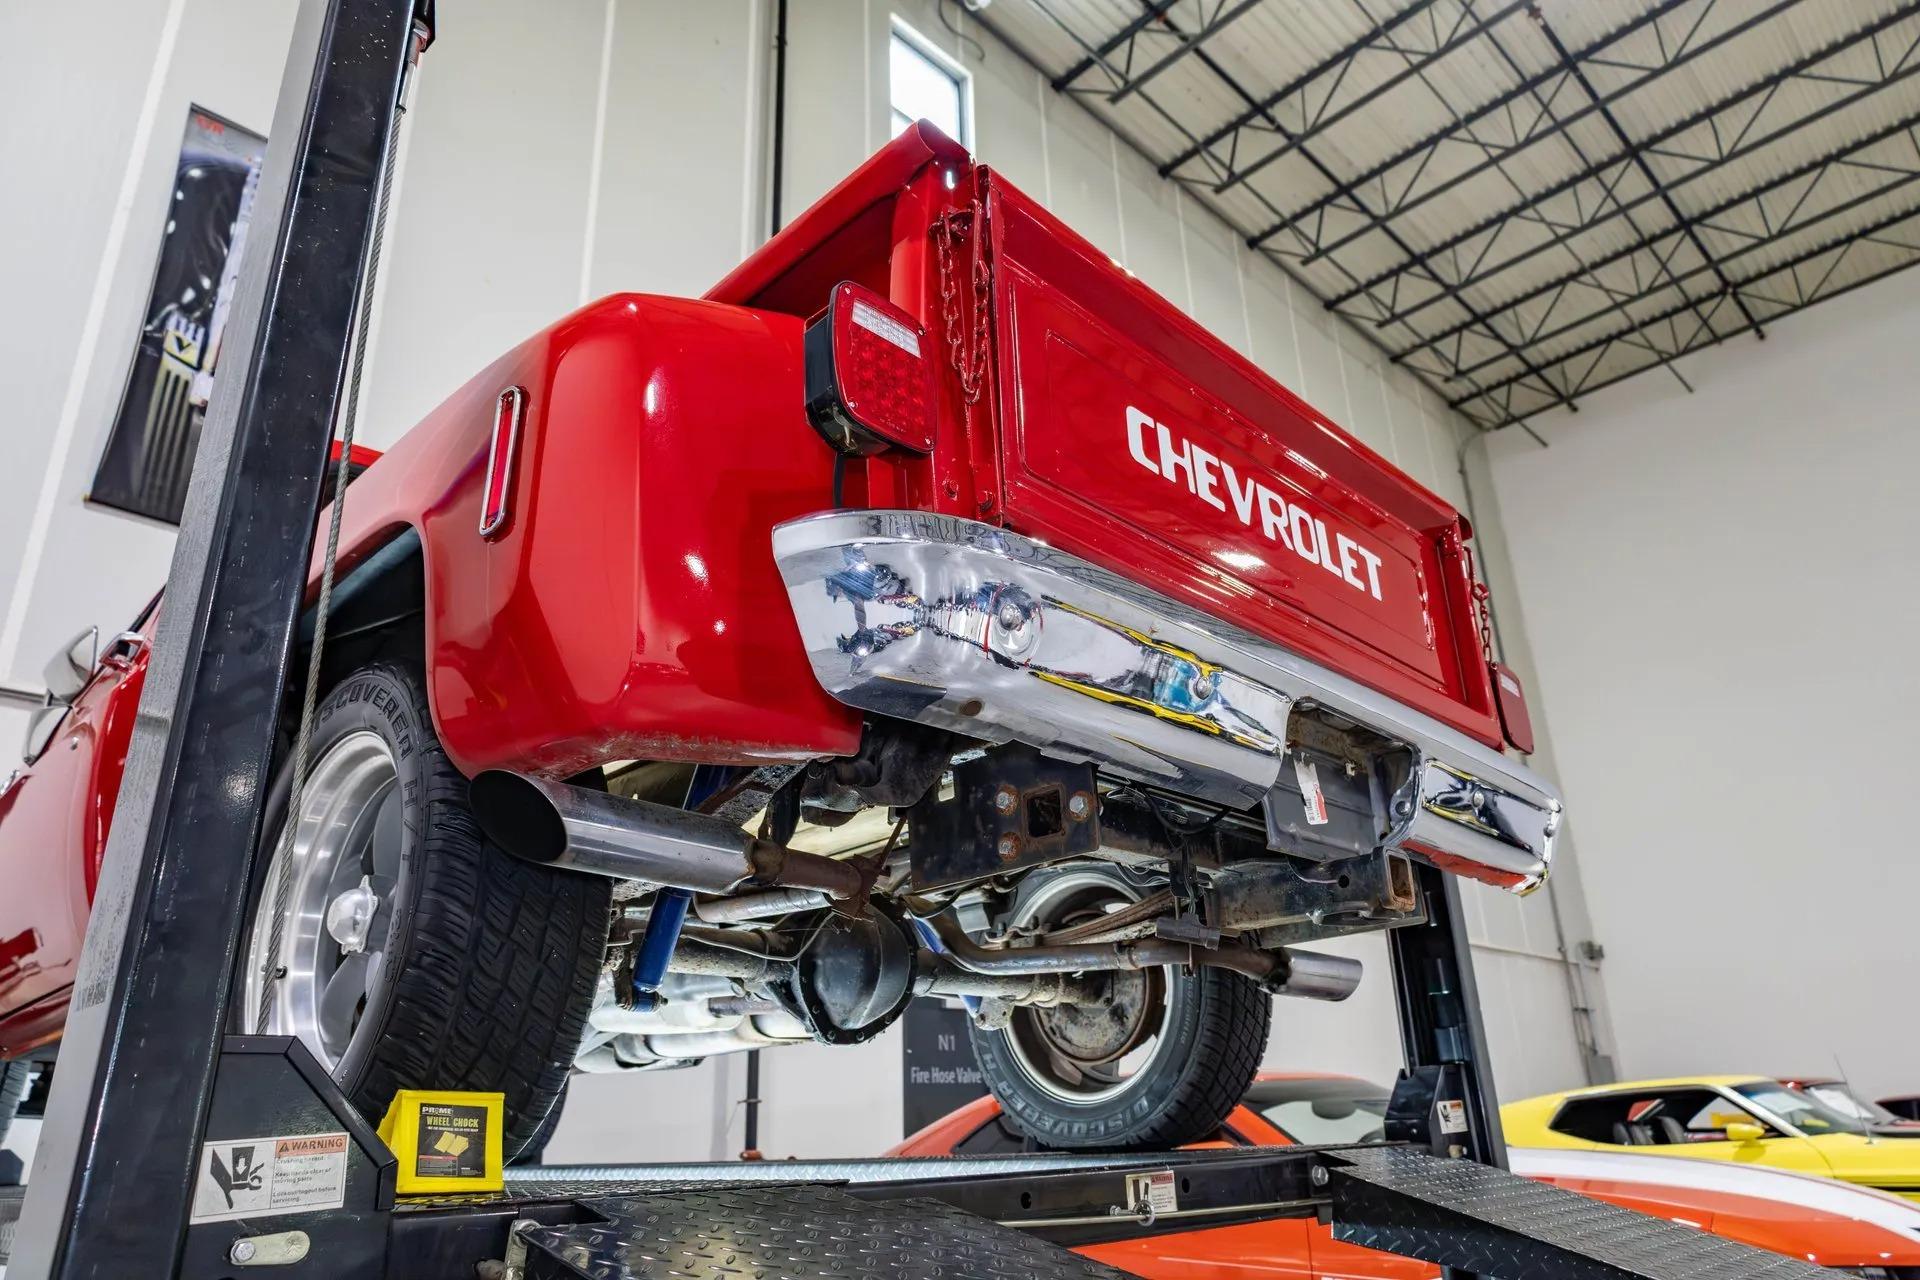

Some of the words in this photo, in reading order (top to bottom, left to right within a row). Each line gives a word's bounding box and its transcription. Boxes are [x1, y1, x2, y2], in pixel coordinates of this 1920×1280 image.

[1125, 405, 1382, 602] CHEVROLET
[313, 682, 414, 759] ISCOVERER
[938, 1034, 955, 1051] N1
[911, 1066, 930, 1084] Fire
[931, 1066, 955, 1084] Hose
[956, 1066, 983, 1084] Valve
[998, 1079, 1150, 1138] DISCOVERER
[426, 1115, 450, 1127] WHEEL
[453, 1117, 479, 1128] CHOCK
[292, 1139, 343, 1150] WARNING
